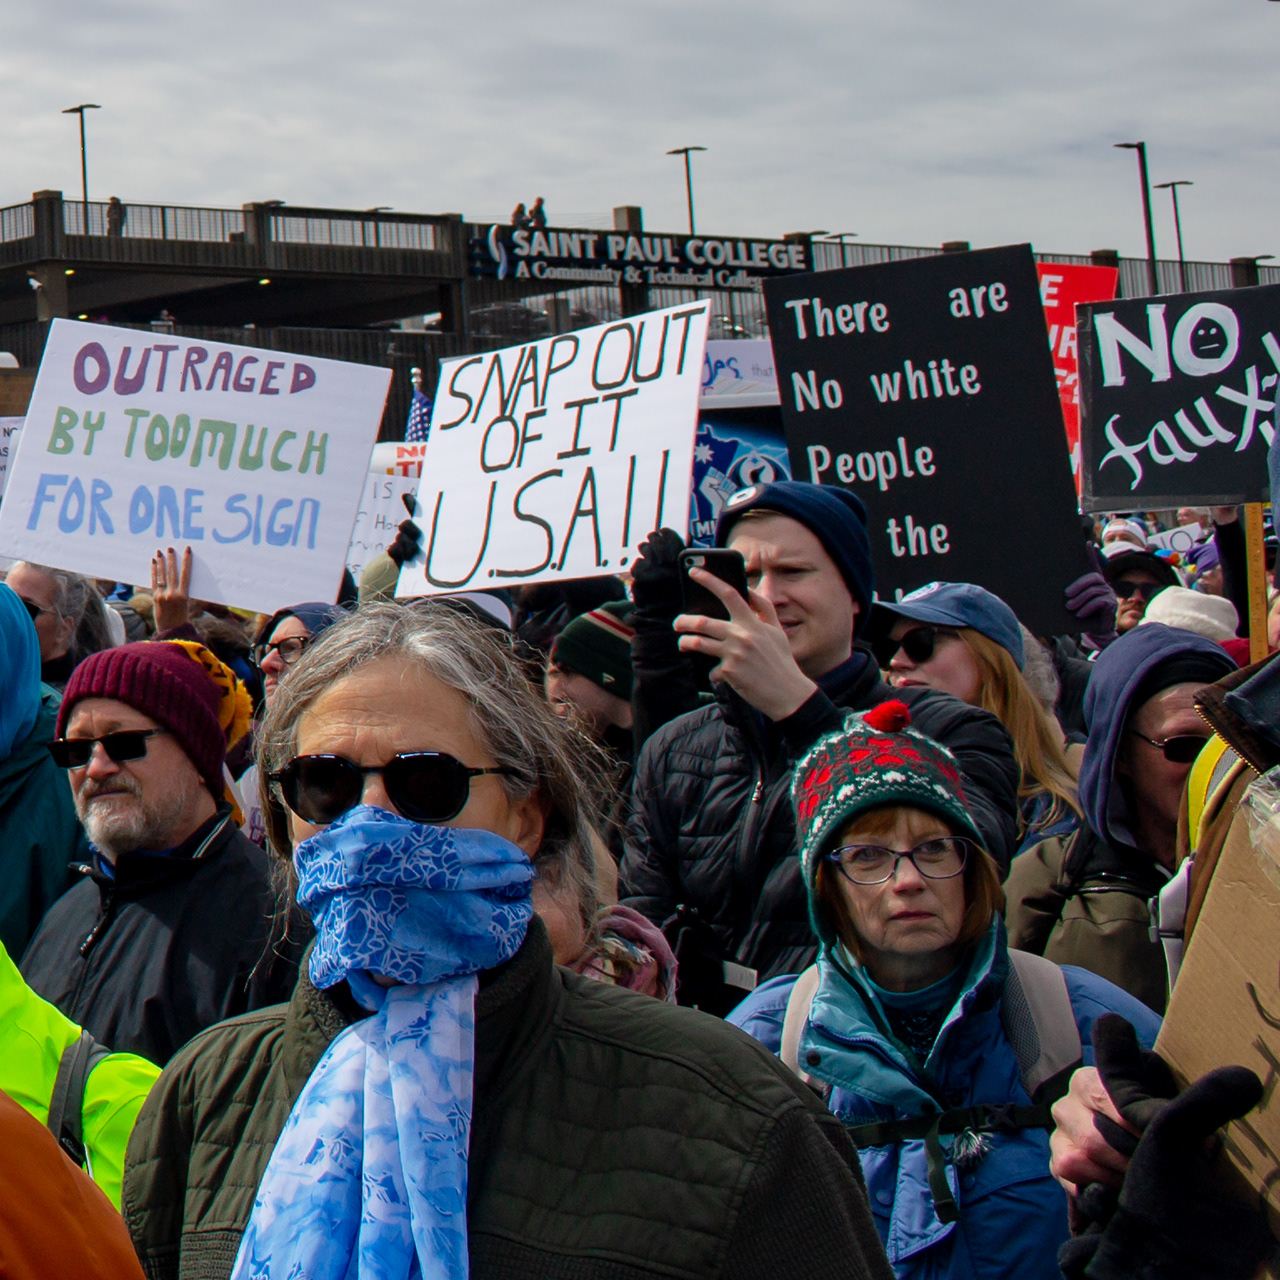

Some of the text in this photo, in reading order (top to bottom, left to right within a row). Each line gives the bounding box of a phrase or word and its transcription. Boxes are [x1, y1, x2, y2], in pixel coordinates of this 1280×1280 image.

[512, 230, 806, 269] SAINT PAUL COLLEGE
[515, 260, 763, 293] A Community & Technical Colleg
[784, 282, 1009, 339] There are
[73, 341, 317, 396] OUTRAGED
[439, 306, 706, 431] SNAP OUT
[1093, 302, 1239, 387] NO
[791, 358, 981, 412] No white
[46, 405, 105, 456] BY
[480, 387, 639, 473] OF IT
[806, 436, 936, 491] People
[25, 472, 321, 550] FOR ONE SIGN
[886, 515, 951, 557] the
